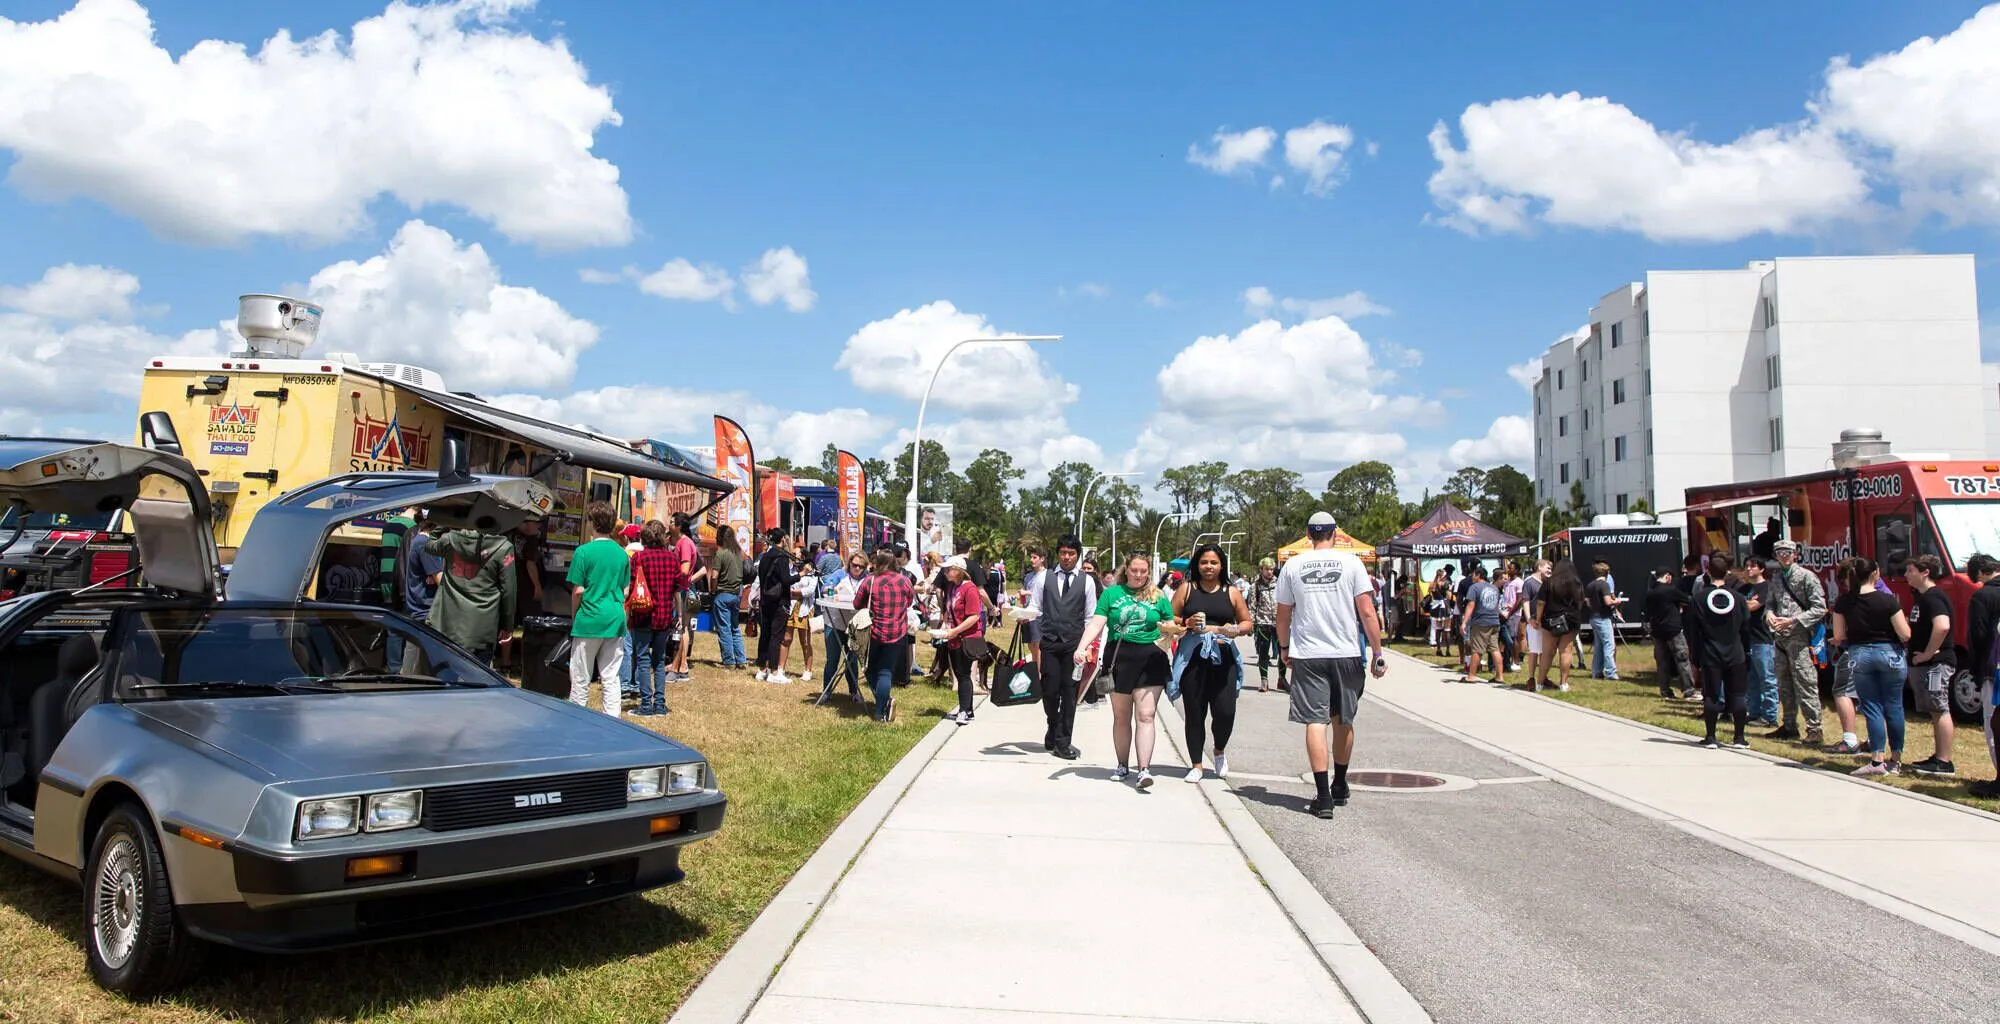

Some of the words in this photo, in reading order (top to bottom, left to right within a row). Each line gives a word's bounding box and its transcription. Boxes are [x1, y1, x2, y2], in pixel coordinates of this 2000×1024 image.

[208, 424, 256, 434] SAWADEE
[232, 434, 256, 442] FOOD
[667, 493, 695, 516] SOUTH
[1432, 520, 1475, 534] TAMALE
[1582, 535, 1617, 544] MEXICAN
[1617, 534, 1647, 543] STREET
[1647, 533, 1669, 543] FOOD
[1412, 544, 1450, 554] MEXICAN
[1452, 544, 1482, 554] STREET
[1485, 543, 1506, 553] FOOD
[1302, 562, 1321, 570] AQUA
